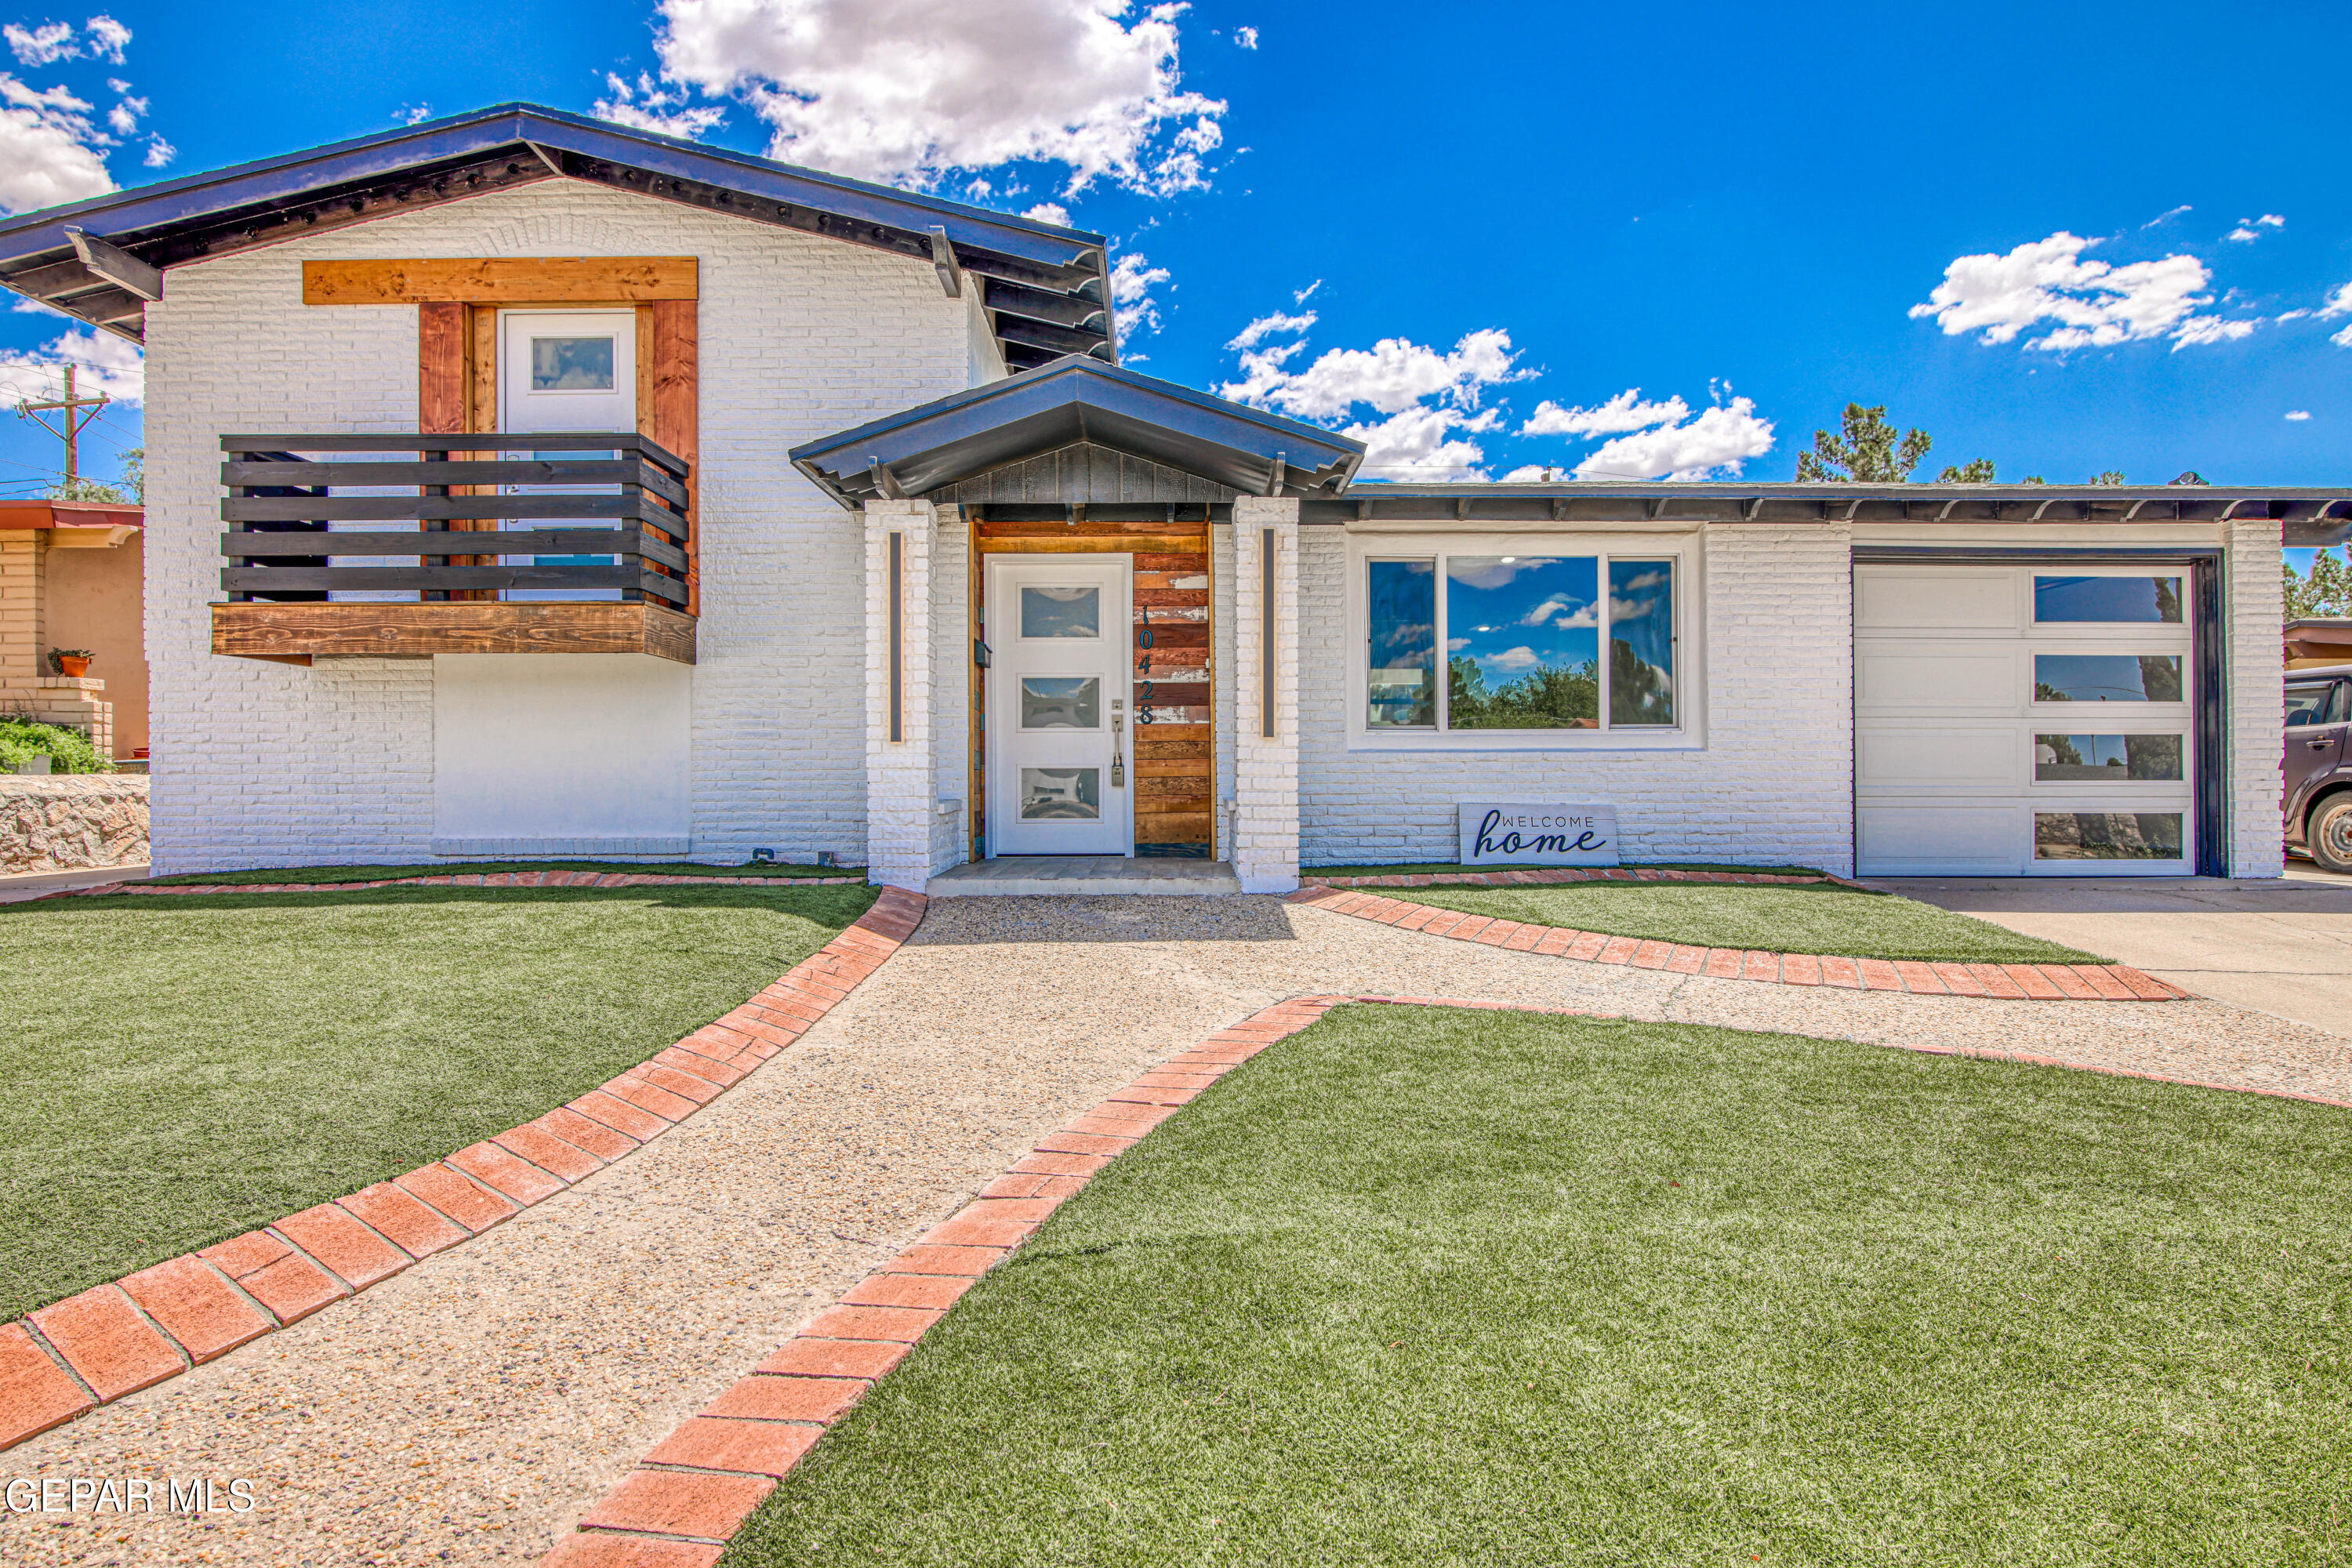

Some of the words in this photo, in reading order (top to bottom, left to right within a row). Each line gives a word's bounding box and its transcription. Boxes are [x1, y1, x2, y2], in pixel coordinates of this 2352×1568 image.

[1138, 605, 1153, 724] 10428
[1474, 809, 1606, 858] home
[1502, 816, 1595, 828] WELCOME
